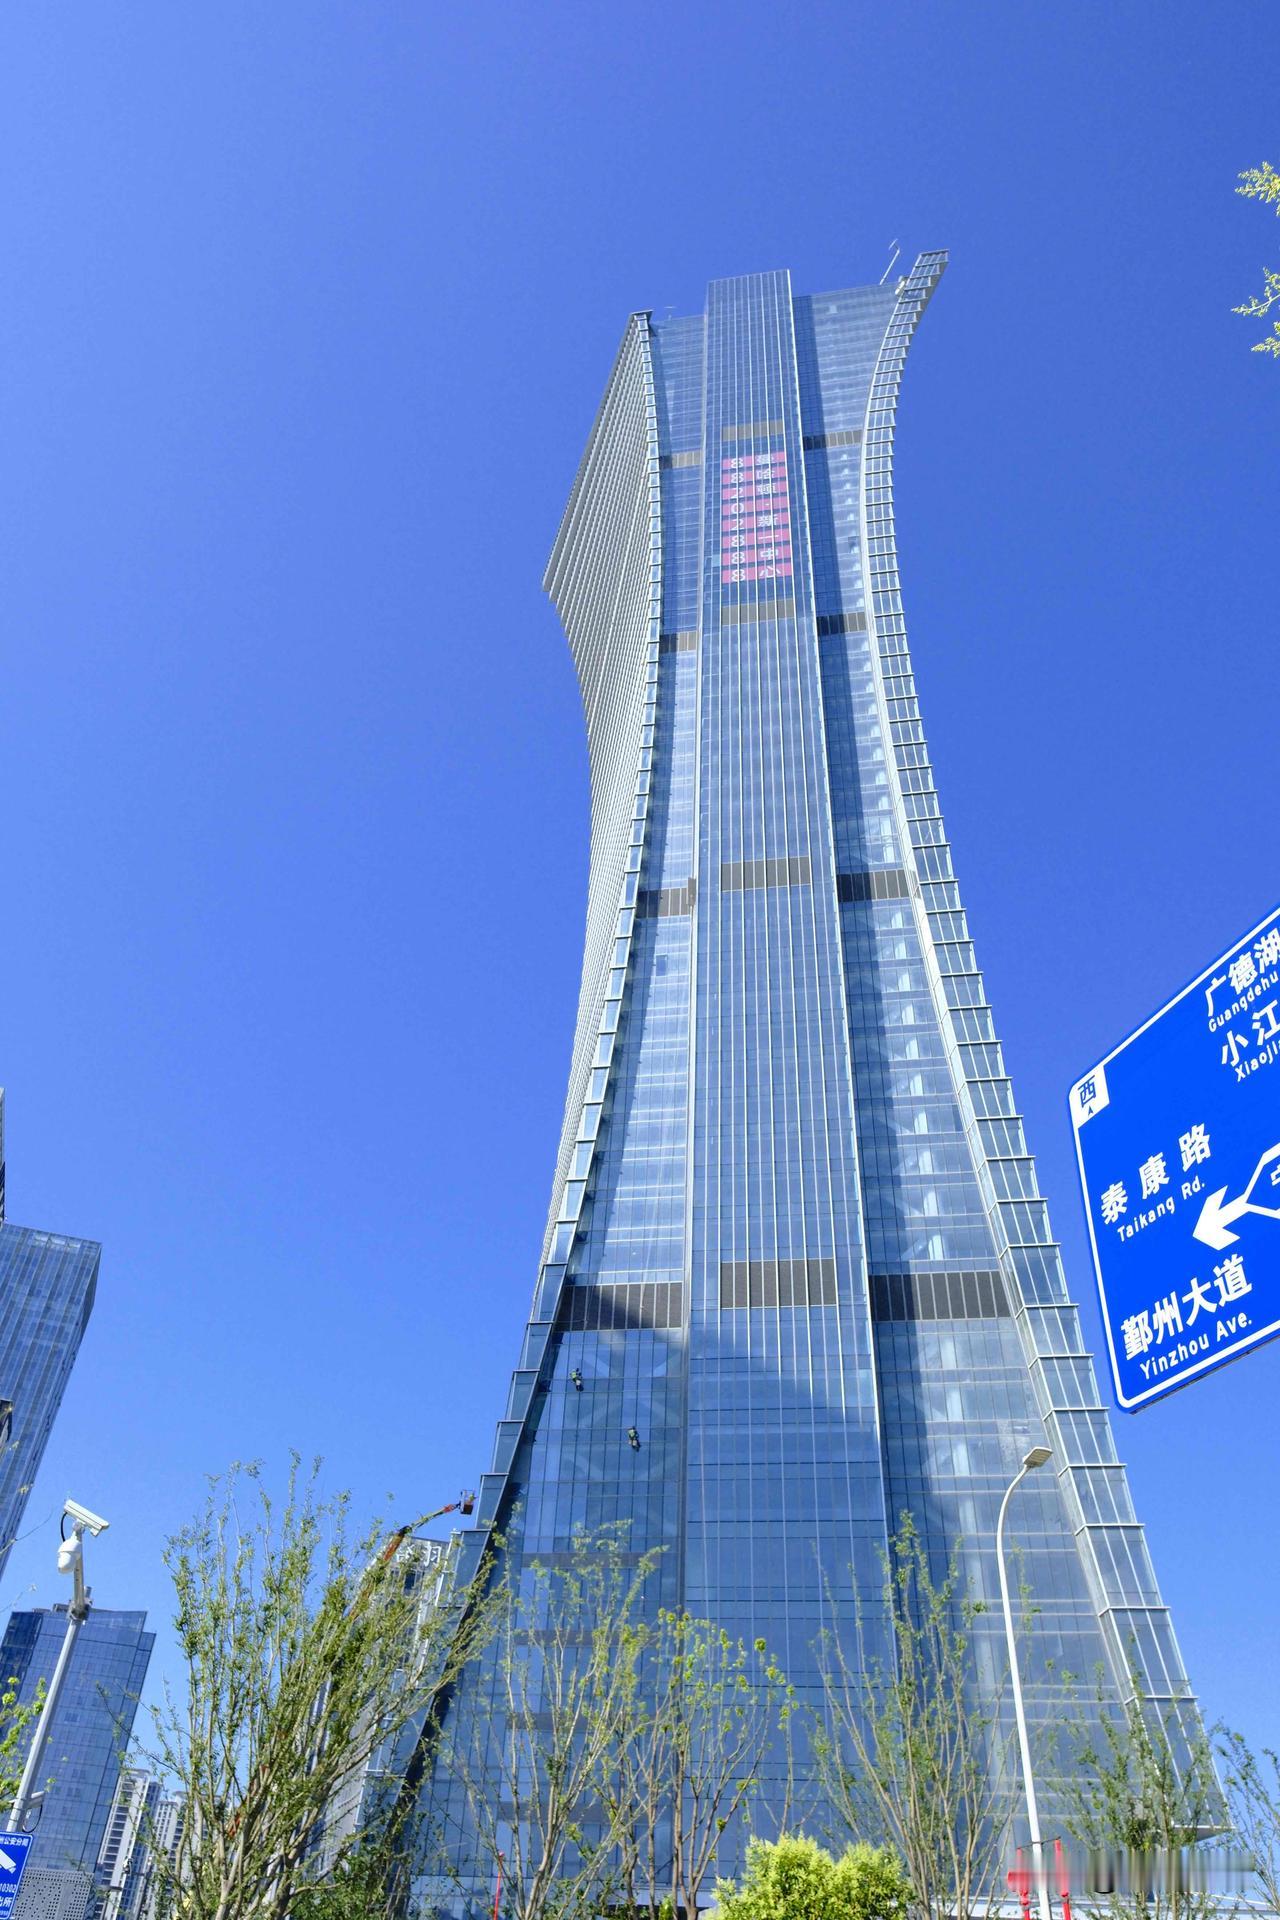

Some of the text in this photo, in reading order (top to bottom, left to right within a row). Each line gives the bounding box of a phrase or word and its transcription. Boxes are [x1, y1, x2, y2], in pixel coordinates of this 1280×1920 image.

[730, 457, 746, 582] 88202888
[1205, 927, 1280, 1017] 广德湖
[1208, 970, 1279, 1033] Guangdehu
[1221, 999, 1280, 1068] 小江
[1234, 1040, 1280, 1083] Xiaoji
[1077, 1074, 1097, 1108] 西
[1100, 1123, 1212, 1225] 泰康路
[1117, 1175, 1206, 1243] Taikang Rd.
[1120, 1253, 1254, 1361] 鄞州大道
[1139, 1312, 1253, 1381] Yinzhou Ave.
